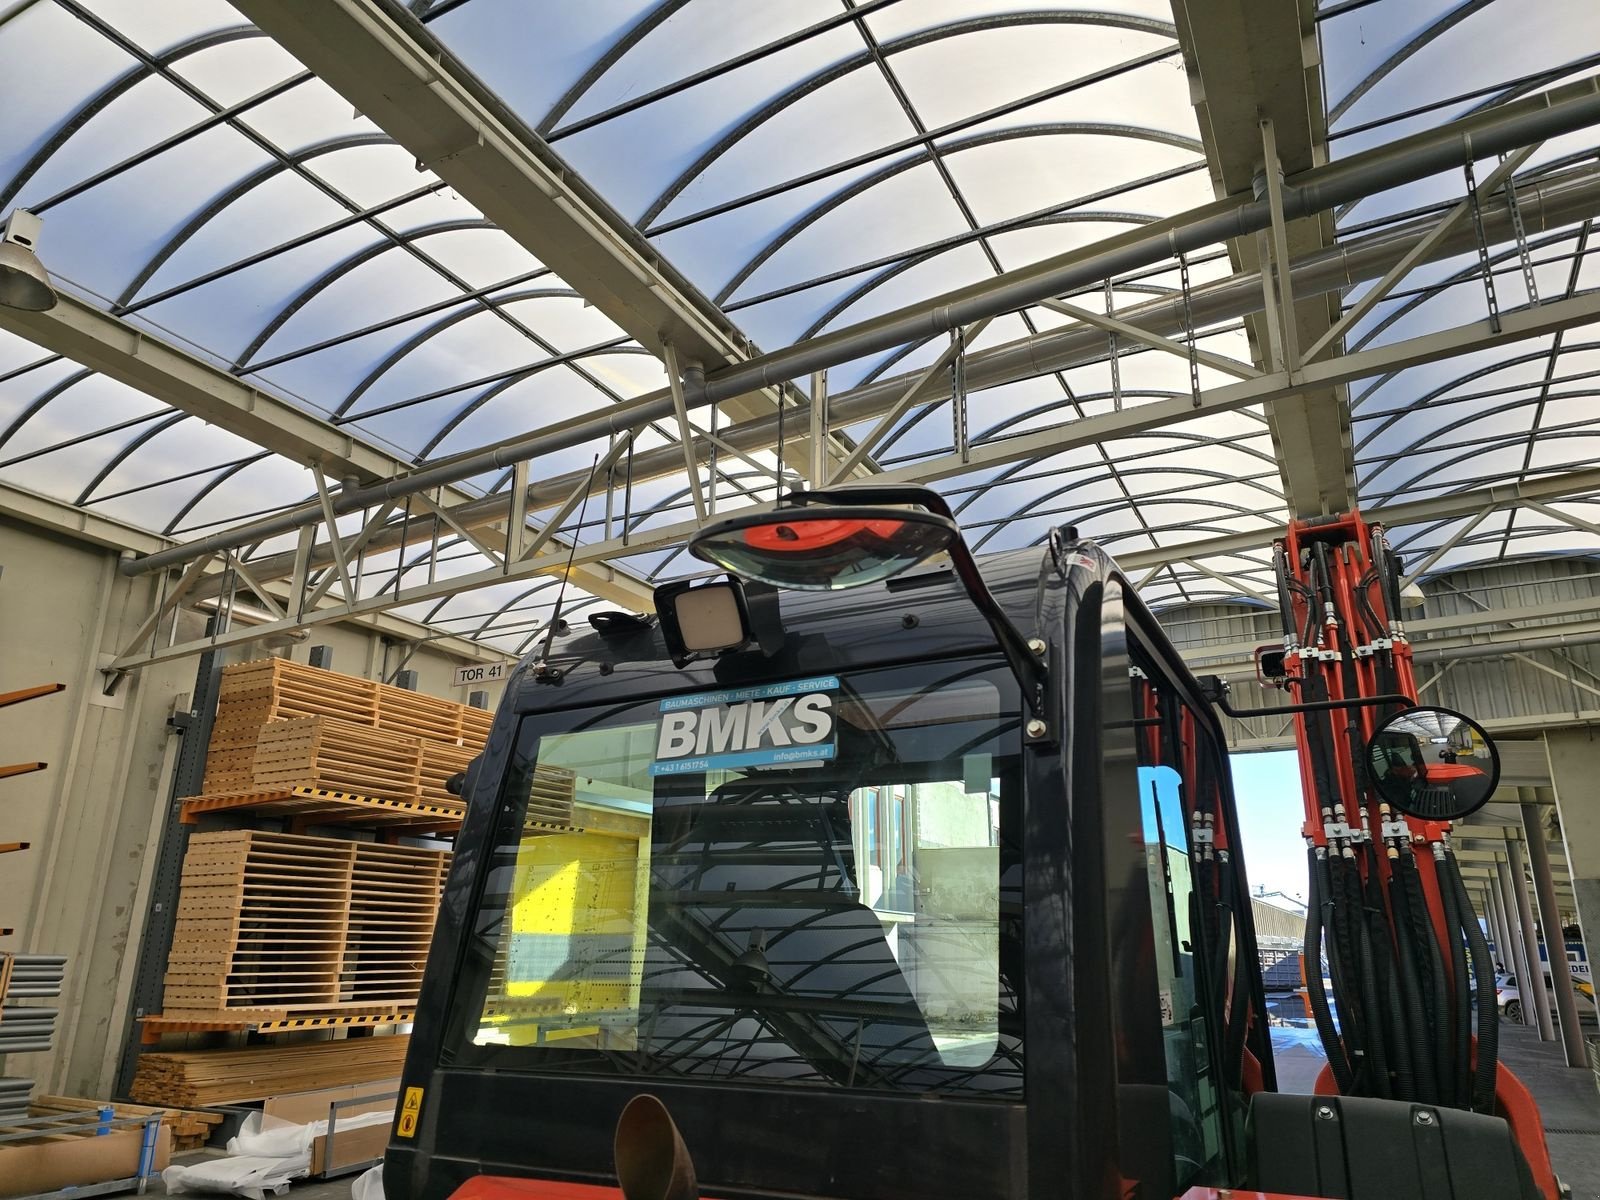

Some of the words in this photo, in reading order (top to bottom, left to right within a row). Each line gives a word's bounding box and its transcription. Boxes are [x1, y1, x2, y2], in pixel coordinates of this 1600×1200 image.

[460, 668, 484, 681] TOR
[488, 665, 502, 677] 41
[665, 694, 729, 709] BAUMASCHINEN
[736, 689, 760, 699] MIETE
[767, 685, 791, 695] KAUF
[797, 679, 835, 691] SERVICE
[656, 693, 833, 760] BMKS
[773, 748, 829, 761] info@bmks.at
